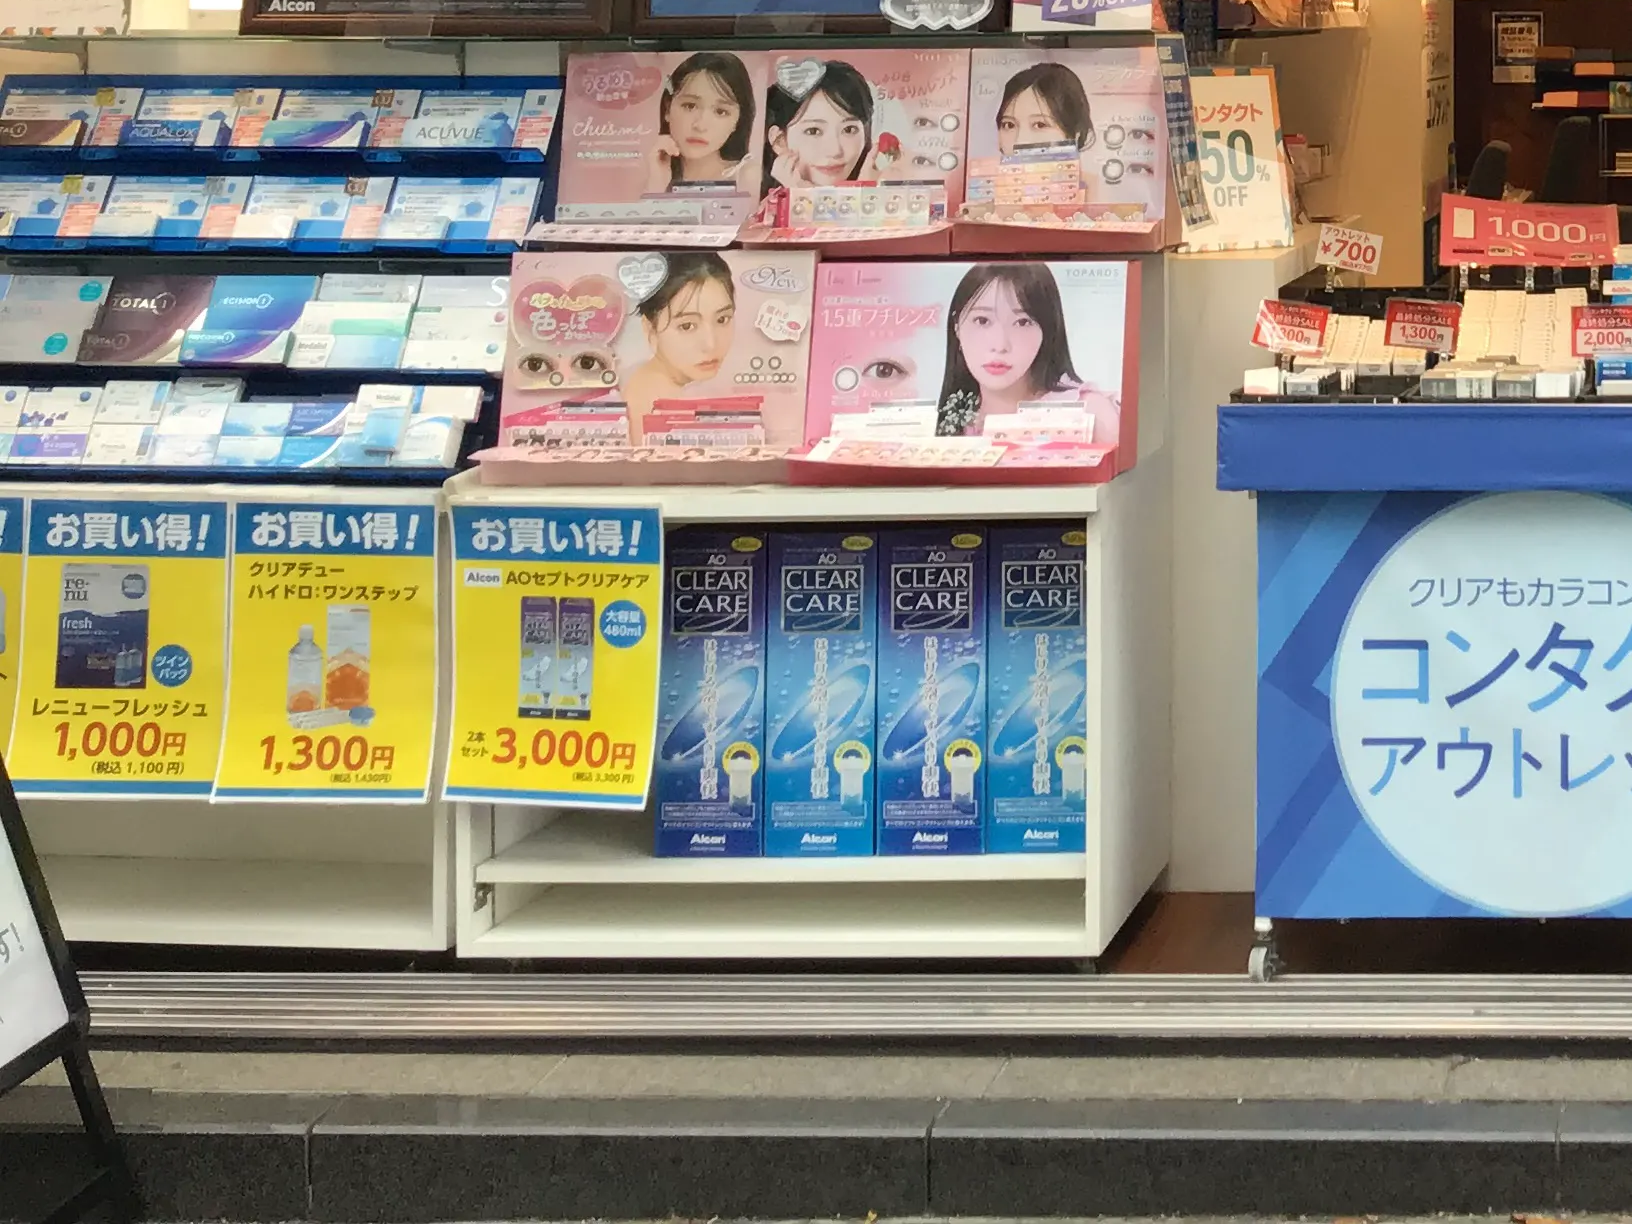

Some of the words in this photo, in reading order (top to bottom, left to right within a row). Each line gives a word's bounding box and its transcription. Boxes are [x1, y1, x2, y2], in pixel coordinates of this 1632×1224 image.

[1193, 102, 1264, 124] ンタクト
[415, 126, 485, 140] ACUVUE
[1213, 186, 1249, 208] OFF
[1325, 226, 1371, 243] アウトレット
[1321, 238, 1377, 265] ¥700
[112, 297, 157, 309] TOTAL
[46, 512, 211, 552] お買い得!
[251, 511, 420, 550] お買い得!
[471, 517, 643, 557] お買い得!
[249, 561, 346, 577] クリアデュー
[466, 572, 500, 584] Alcon
[506, 570, 650, 588] AOセプトクリアケア
[895, 568, 968, 588] CLEAR
[1006, 565, 1079, 585] CLEAR
[675, 570, 748, 591] CLEAR
[785, 569, 859, 590] CLEAR
[675, 594, 748, 613] CARE
[785, 593, 860, 613] CARE
[895, 591, 969, 611] CARE
[1006, 588, 1080, 609] CARE
[62, 616, 93, 630] fresh
[605, 610, 641, 624] 大容量
[32, 698, 208, 717] レニューフレッシュ
[54, 721, 187, 761] 1,000円
[491, 727, 636, 770] 3,000円
[260, 734, 396, 775] 1,300円
[690, 832, 727, 845] Alcon
[800, 832, 838, 845] Alcon
[911, 830, 949, 844] Alcon
[1022, 829, 1060, 842] Alcon
